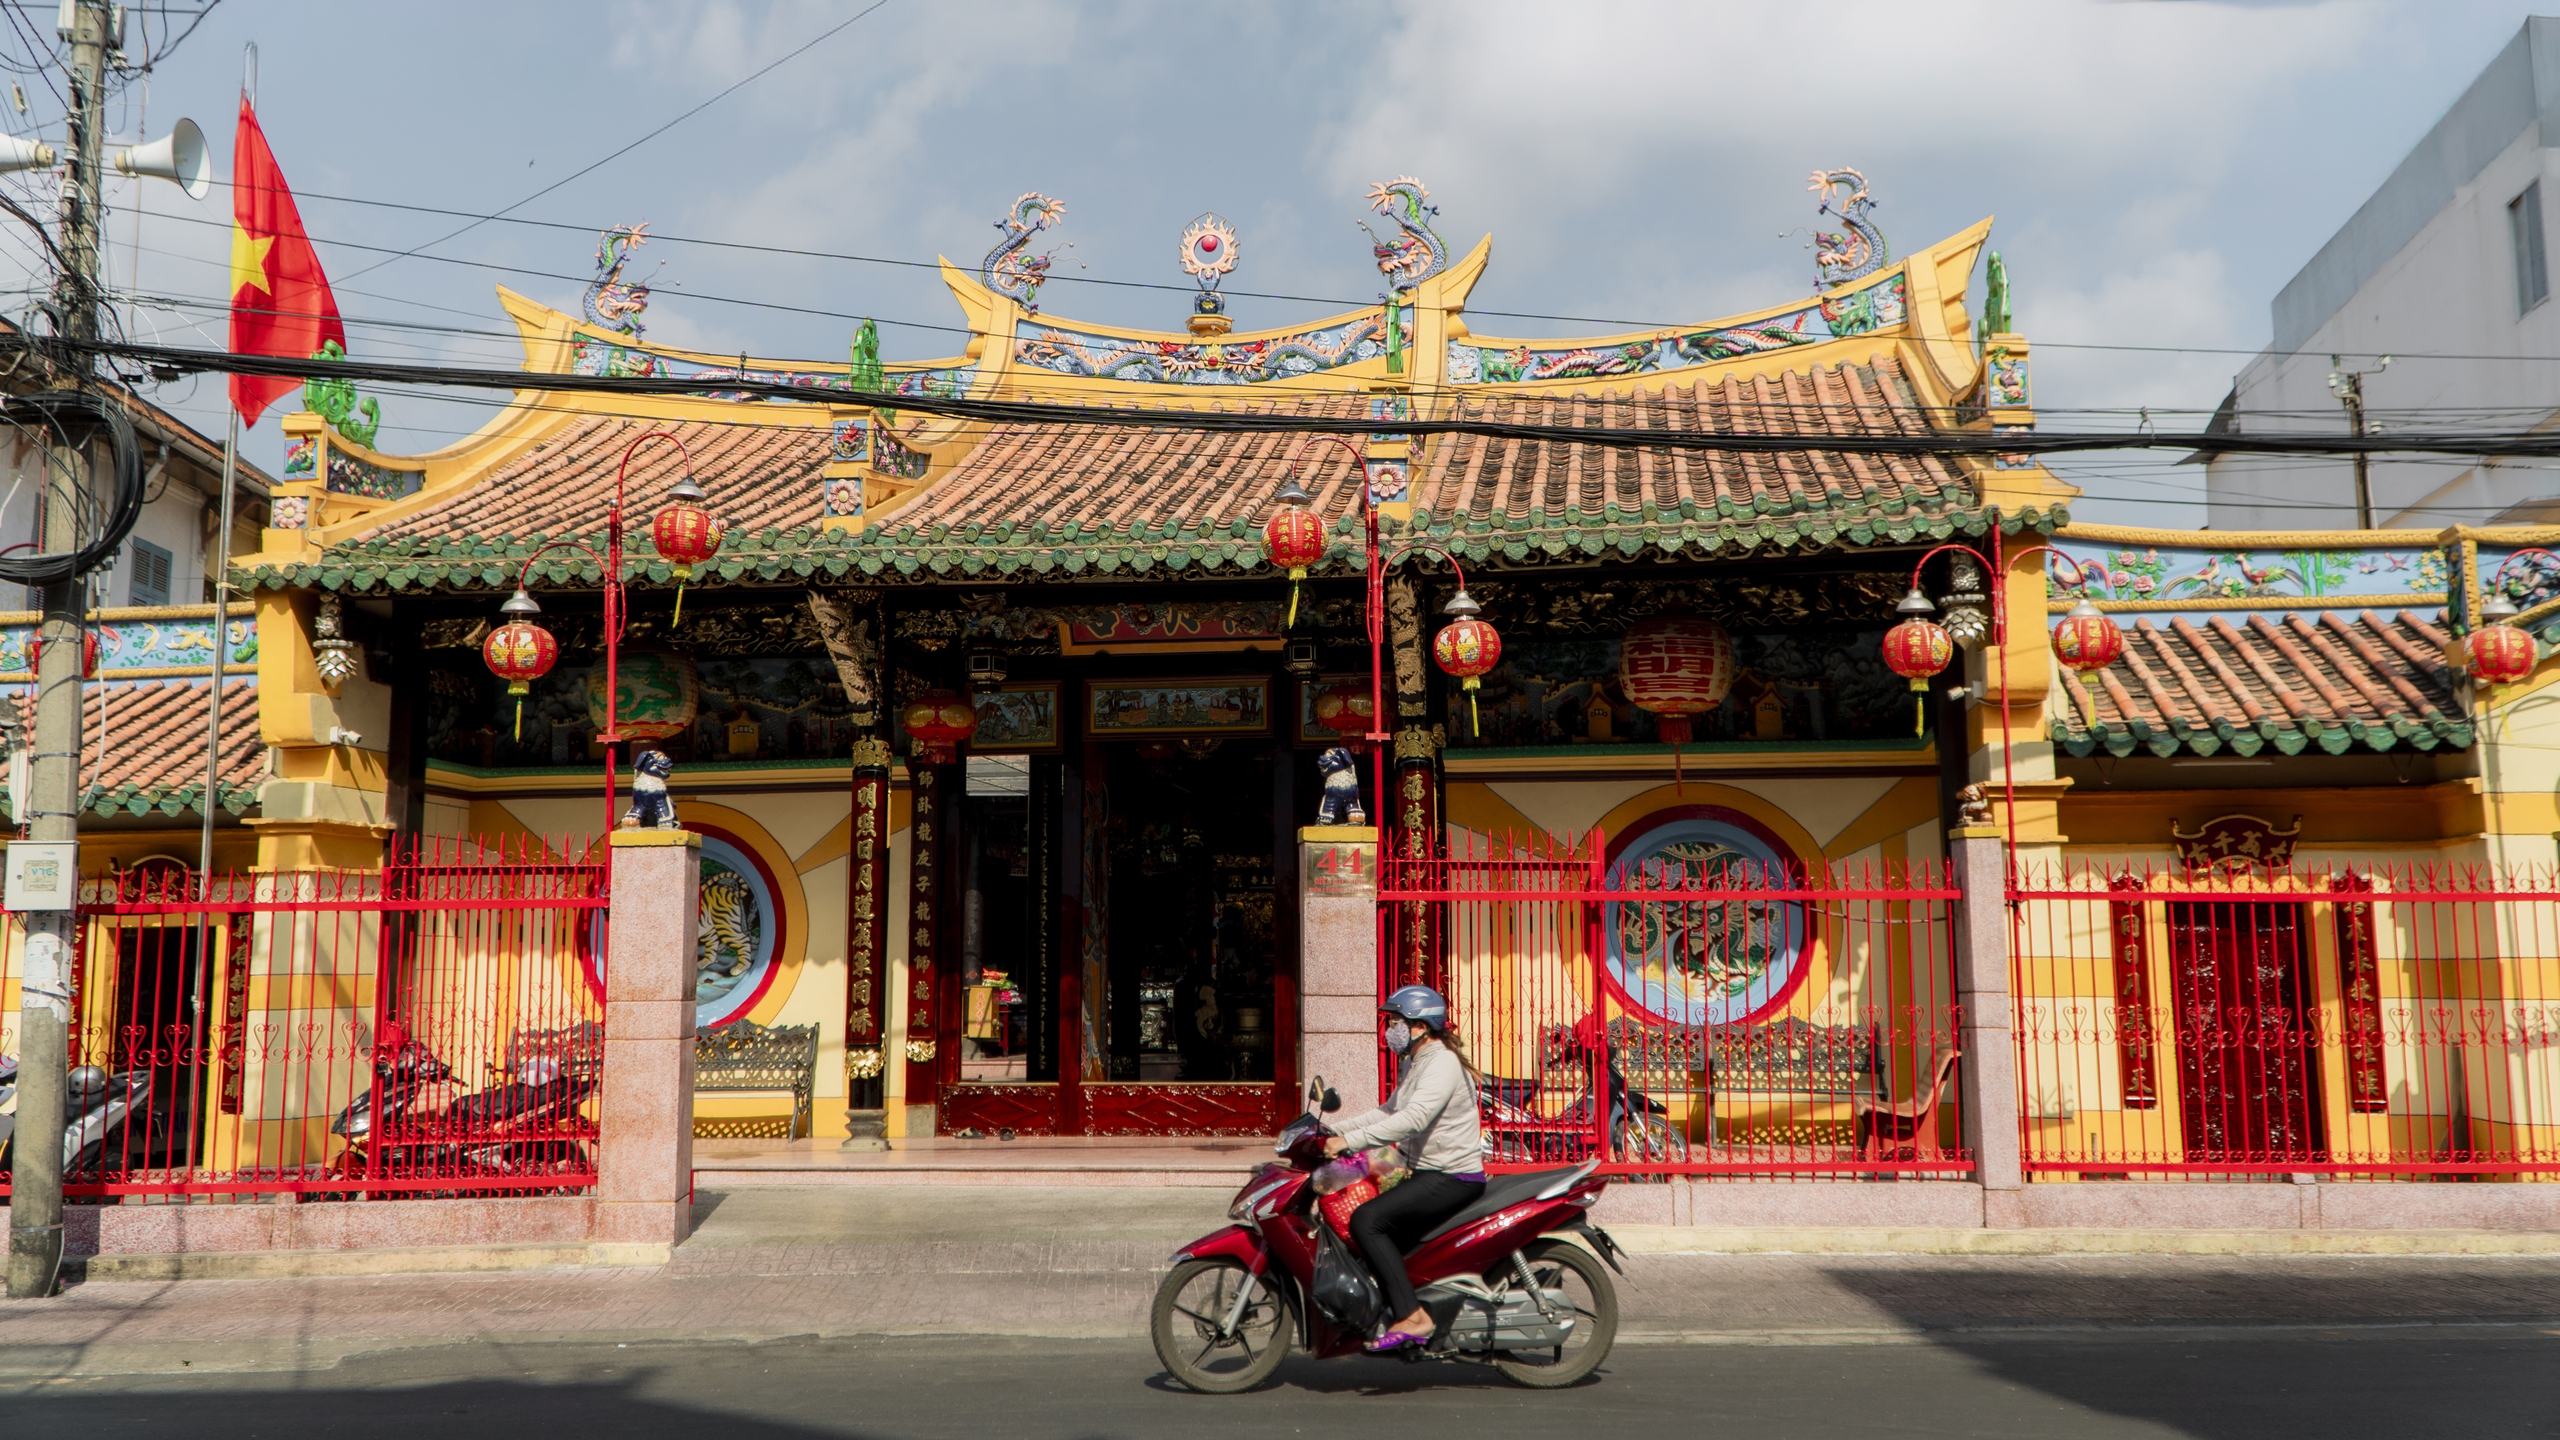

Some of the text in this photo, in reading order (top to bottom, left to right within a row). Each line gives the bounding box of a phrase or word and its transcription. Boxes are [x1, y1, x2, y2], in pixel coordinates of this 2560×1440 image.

[1302, 514, 1316, 552] 大吉大利
[1317, 847, 1364, 874] 44
[40, 922, 46, 931] 2
